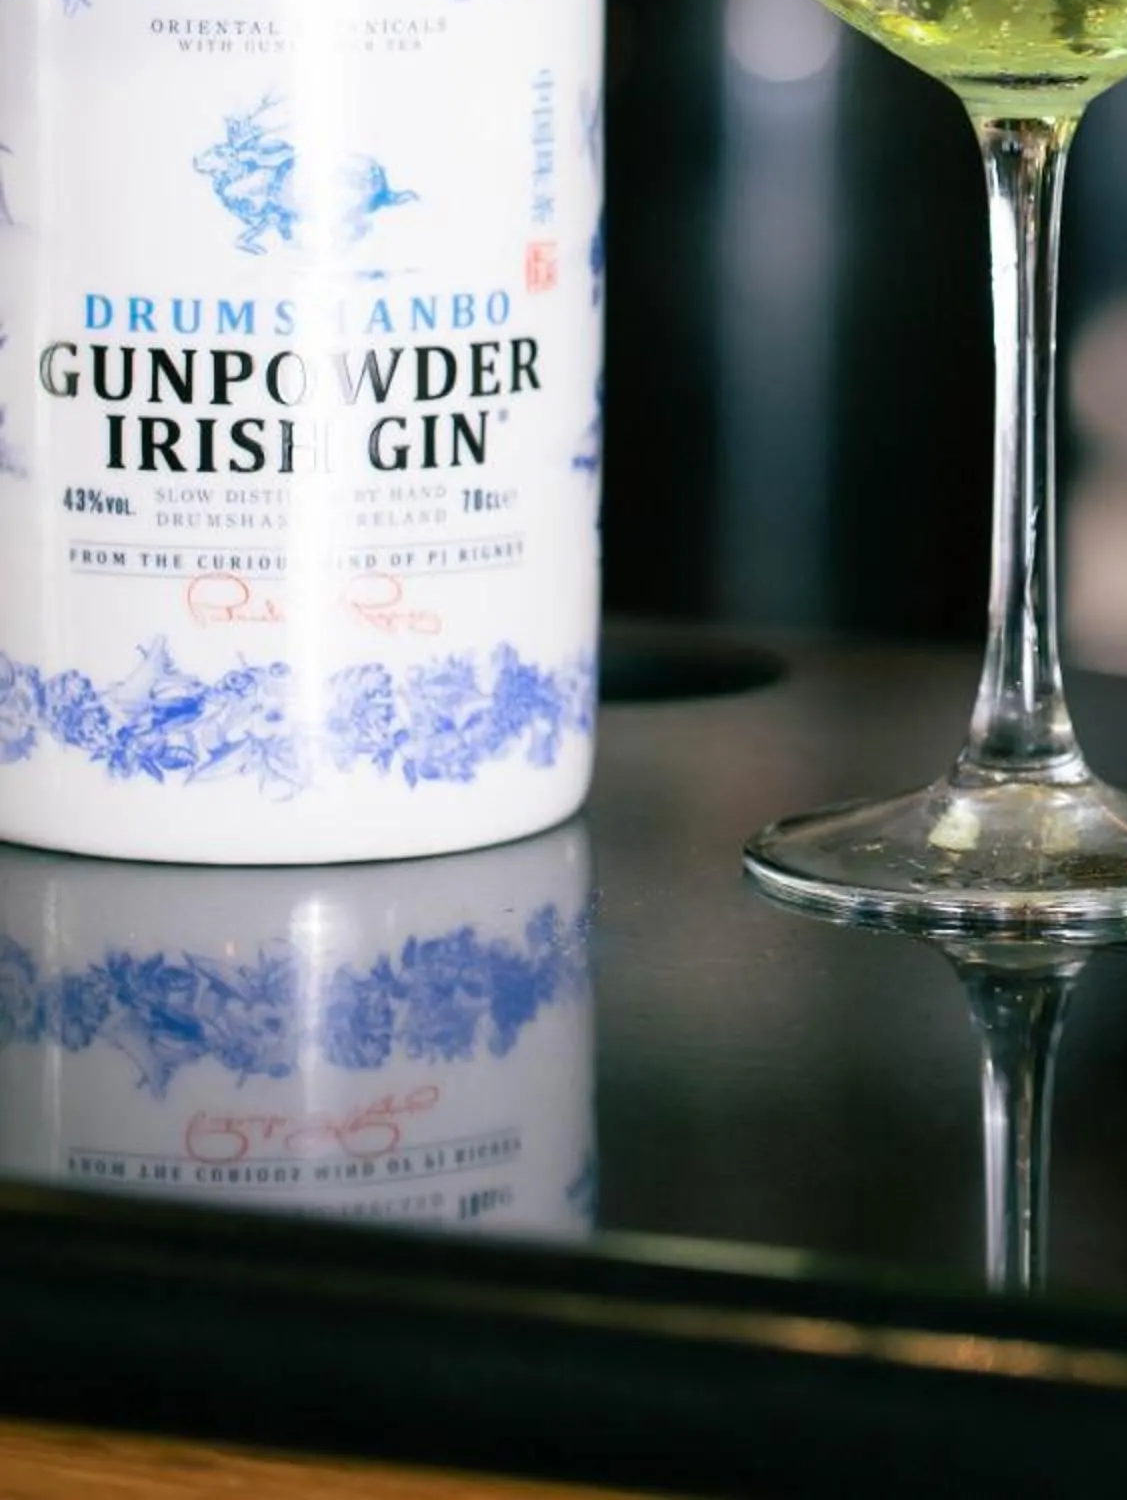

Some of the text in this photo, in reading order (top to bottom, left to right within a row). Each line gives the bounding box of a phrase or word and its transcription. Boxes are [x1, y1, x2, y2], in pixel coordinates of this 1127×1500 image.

[150, 18, 279, 36] ORIENTAL
[178, 39, 233, 53] WITH
[40, 337, 542, 405] GUNPOWDER
[105, 414, 333, 474] IRISH
[155, 487, 211, 504] SLOW
[391, 484, 447, 501] HAND
[69, 548, 126, 566] FROM
[140, 554, 181, 569] THE
[197, 556, 287, 572] CURIOU
[390, 552, 414, 567] OF
